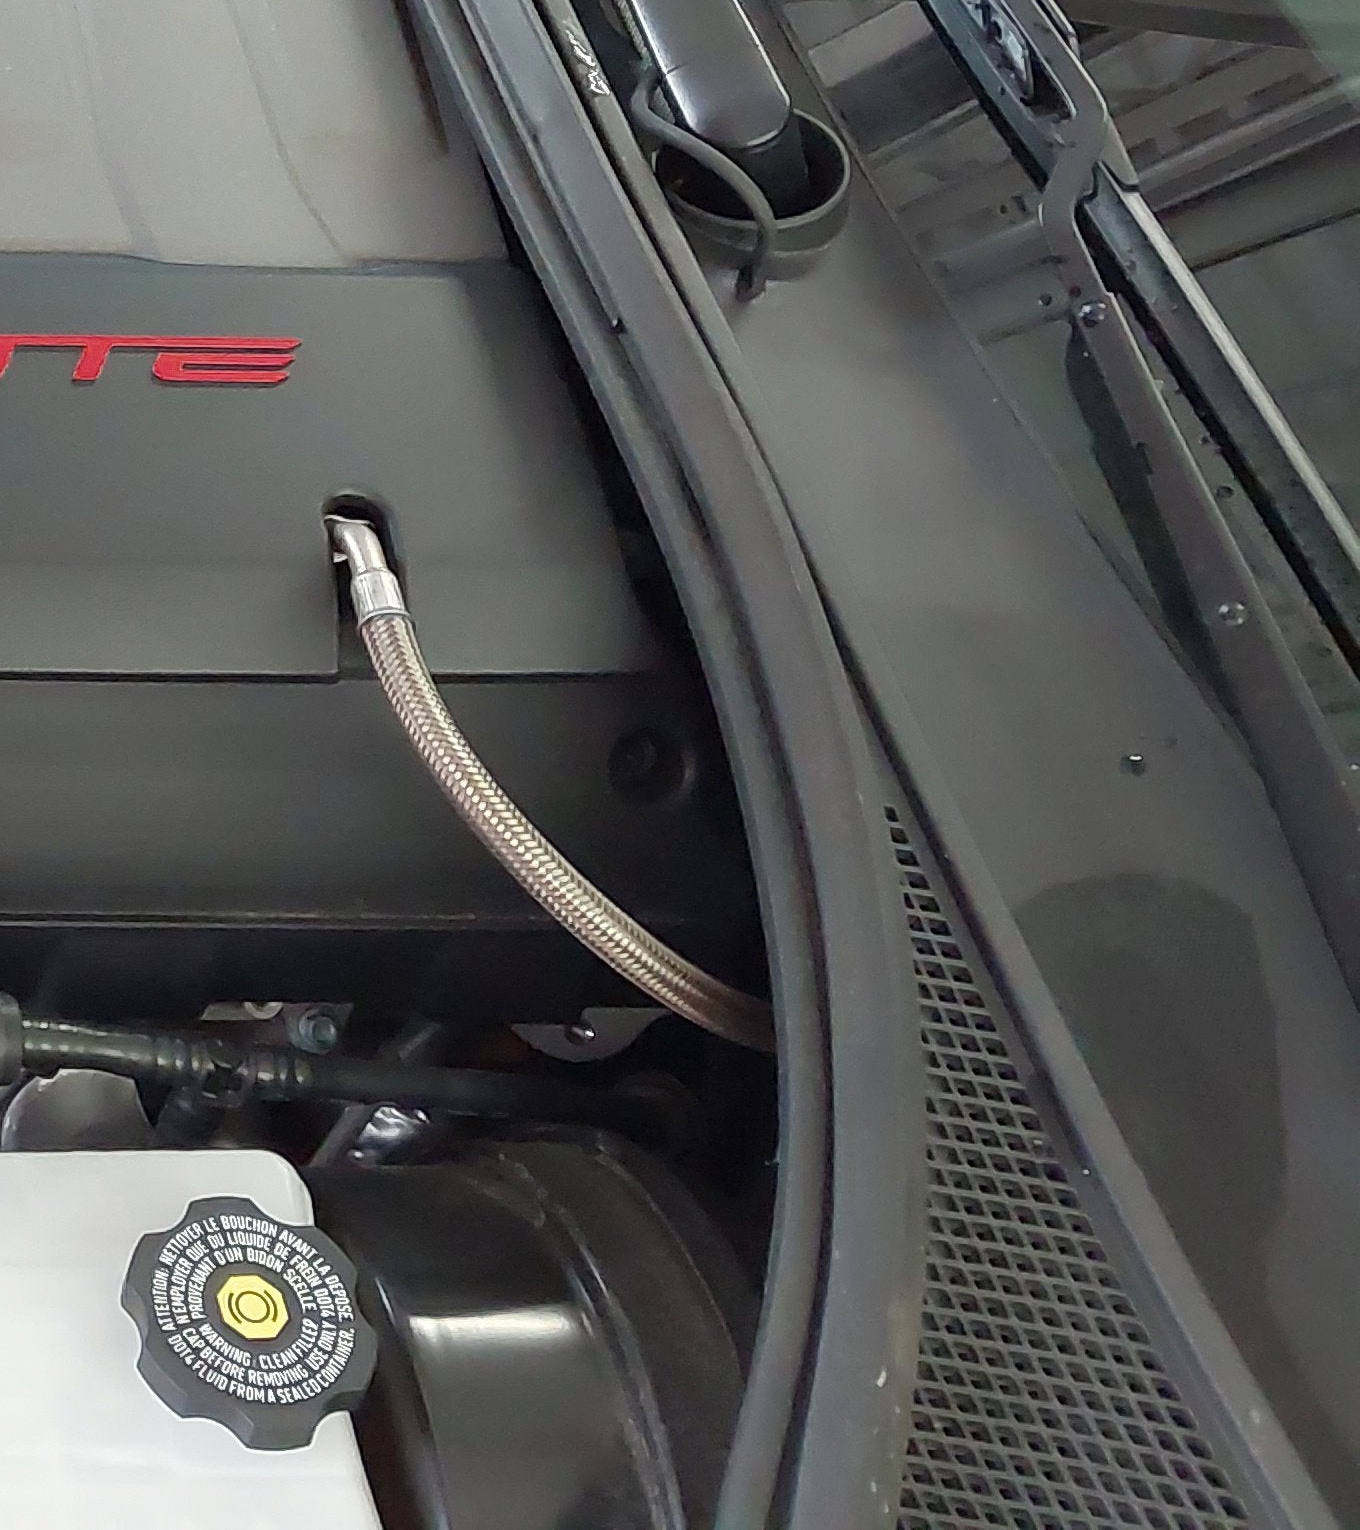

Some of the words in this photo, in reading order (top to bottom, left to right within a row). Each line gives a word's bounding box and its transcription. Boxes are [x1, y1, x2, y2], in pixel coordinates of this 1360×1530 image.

[159, 1223, 204, 1266] NETTOYER
[203, 1217, 220, 1232] LE
[220, 1215, 277, 1237] BOUCHON
[279, 1230, 318, 1259] AVANT
[313, 1257, 331, 1276] LA
[186, 1240, 209, 1261] QUE
[207, 1232, 225, 1249] DU
[226, 1231, 272, 1253] LIQUIDE
[273, 1242, 291, 1260] DE
[289, 1255, 322, 1287] FREIN
[313, 1288, 335, 1317] DOT4
[188, 1256, 216, 1320] PROVENANT
[214, 1247, 243, 1265] D'UN
[247, 1247, 284, 1272] BIDON
[283, 1268, 317, 1313] SCELLE
[167, 1334, 196, 1365] DOT4
[192, 1360, 228, 1391] FLUID
[229, 1380, 264, 1403] FROM
[267, 1389, 276, 1404] A
[277, 1379, 322, 1404] SEALED
[182, 1328, 205, 1348] CAP
[200, 1346, 246, 1382] BEFORE
[304, 1347, 329, 1370] USE
[317, 1320, 337, 1351] ONLY
[259, 1348, 298, 1370] CLEAN
[292, 1317, 319, 1357] FILLER
